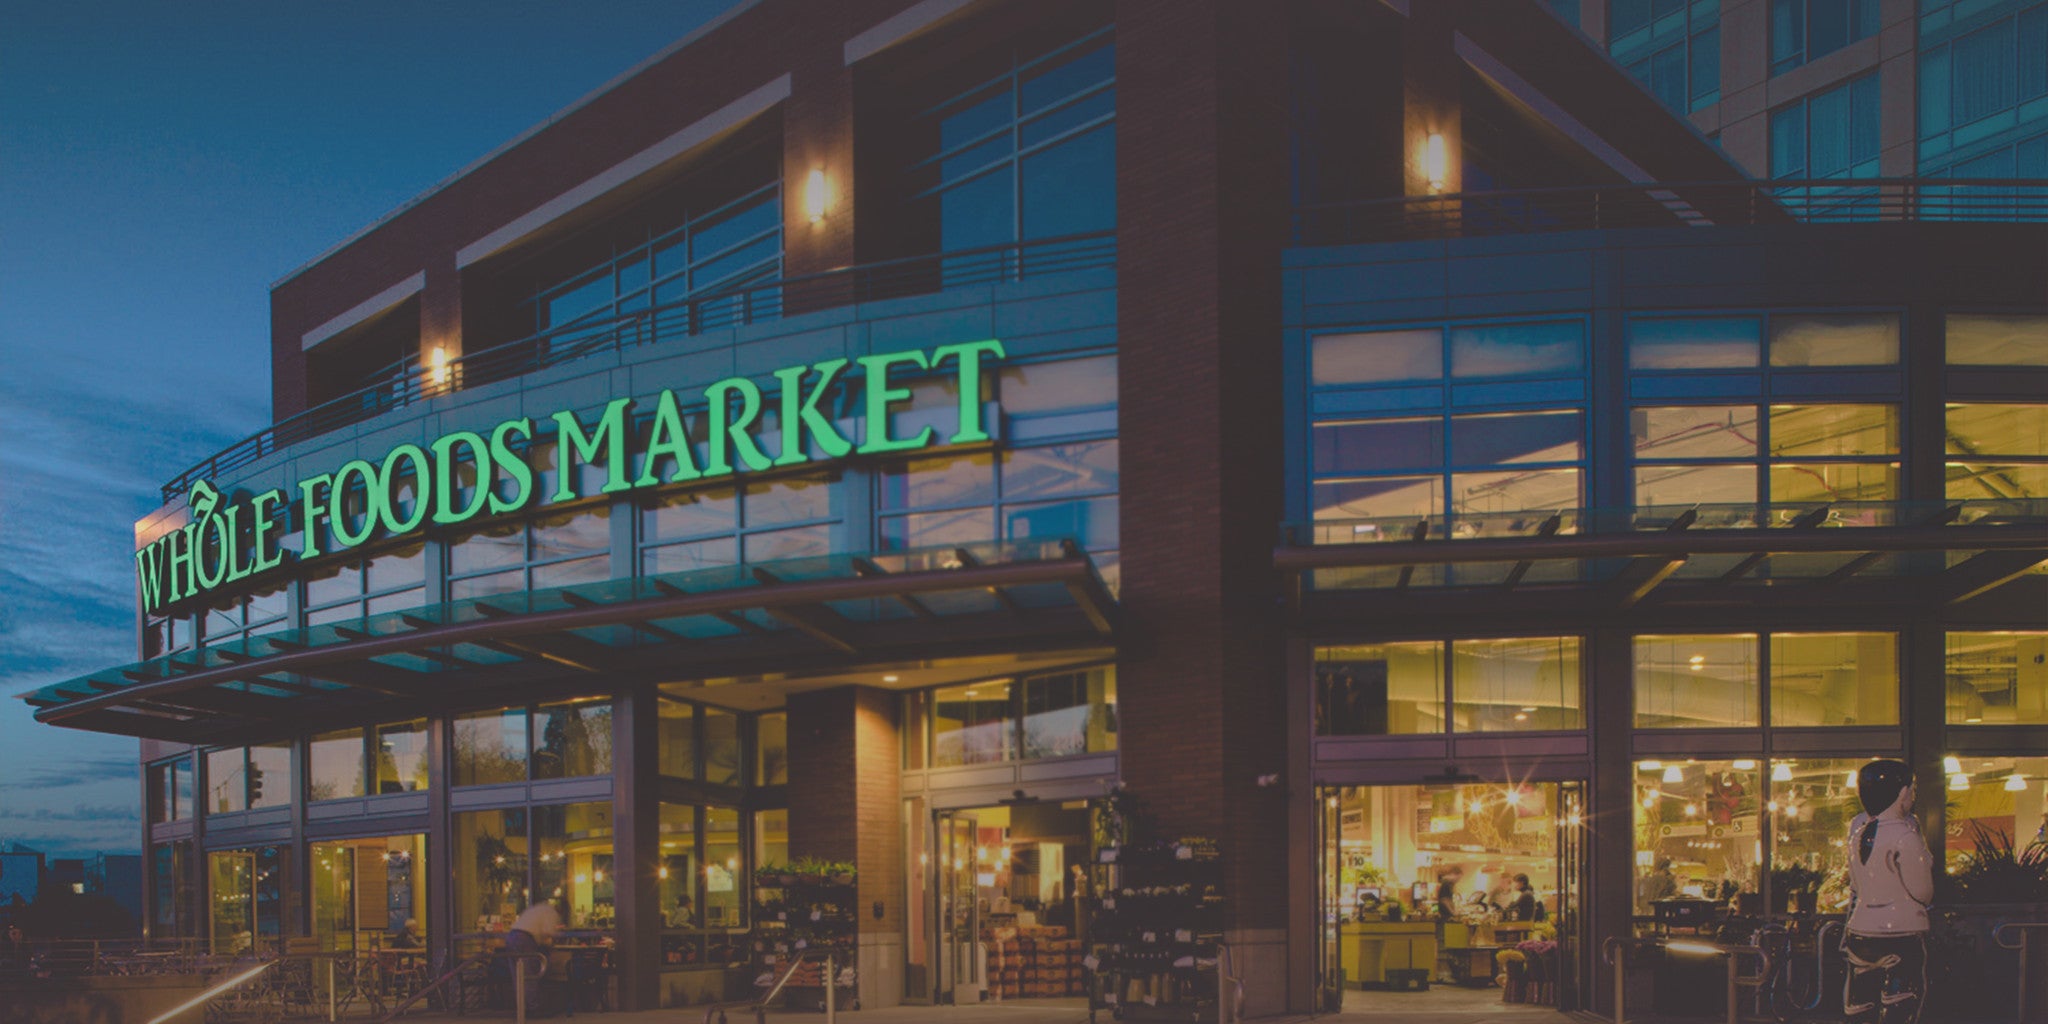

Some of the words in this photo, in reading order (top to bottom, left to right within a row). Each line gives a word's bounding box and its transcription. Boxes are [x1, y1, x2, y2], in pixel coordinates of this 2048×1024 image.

[136, 482, 284, 614] WHOLE
[299, 418, 531, 558] FOODS
[553, 341, 1004, 503] MARKET
